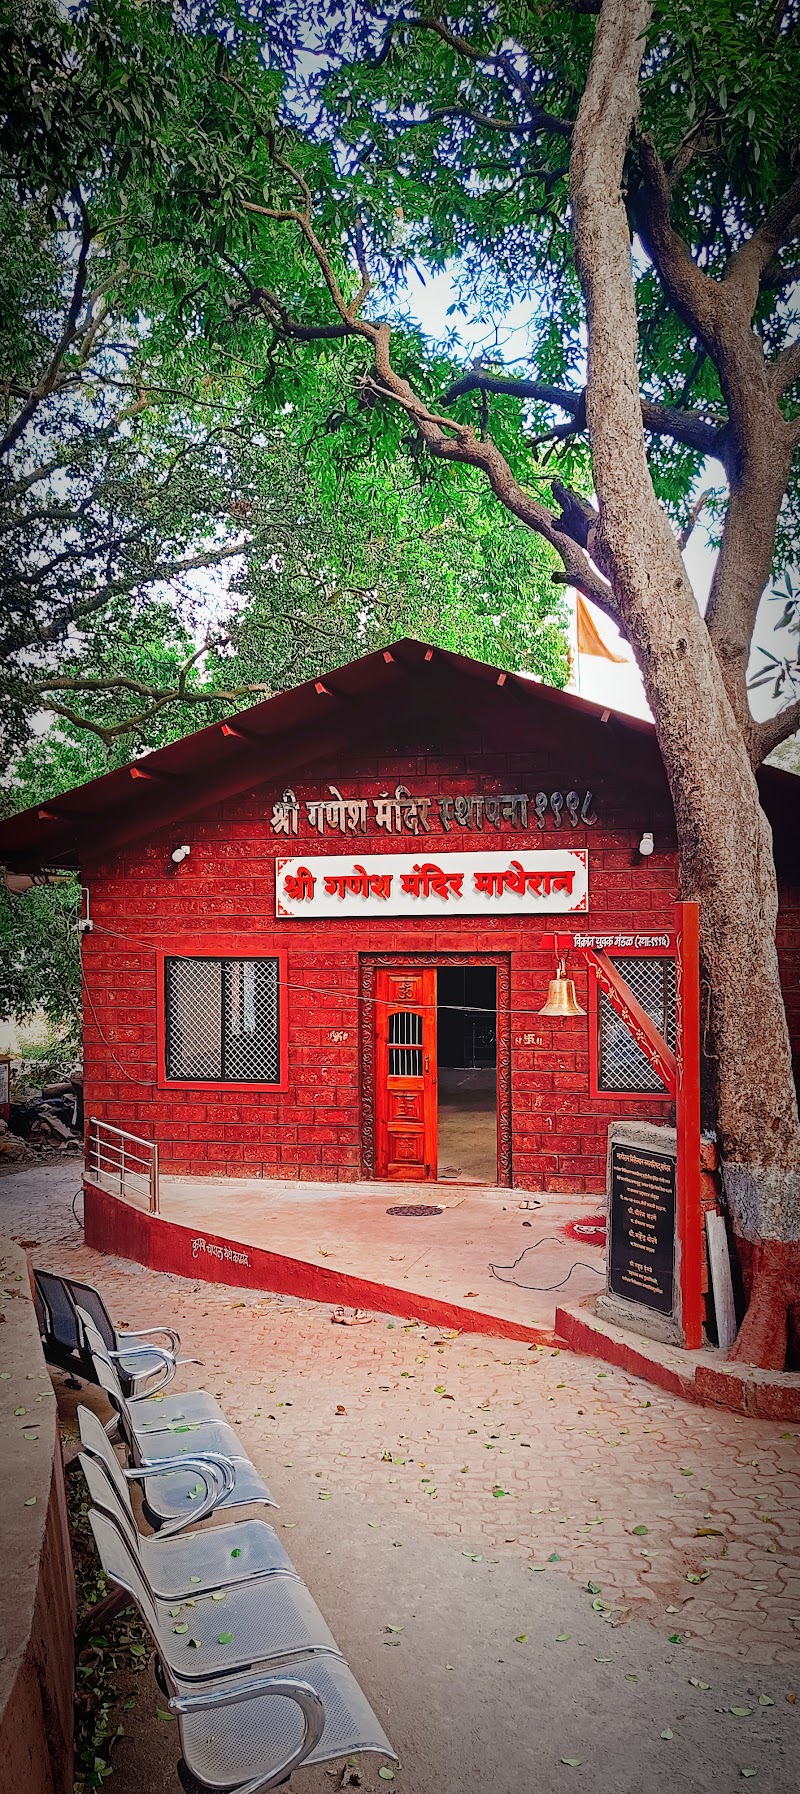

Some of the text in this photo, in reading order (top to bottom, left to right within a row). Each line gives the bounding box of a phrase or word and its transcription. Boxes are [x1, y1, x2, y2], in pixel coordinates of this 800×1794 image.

[270, 785, 597, 836] श्री गणेश मंदिर स्थापना १९९८
[283, 861, 576, 901] श्री गणेश मंदिर माथेरान
